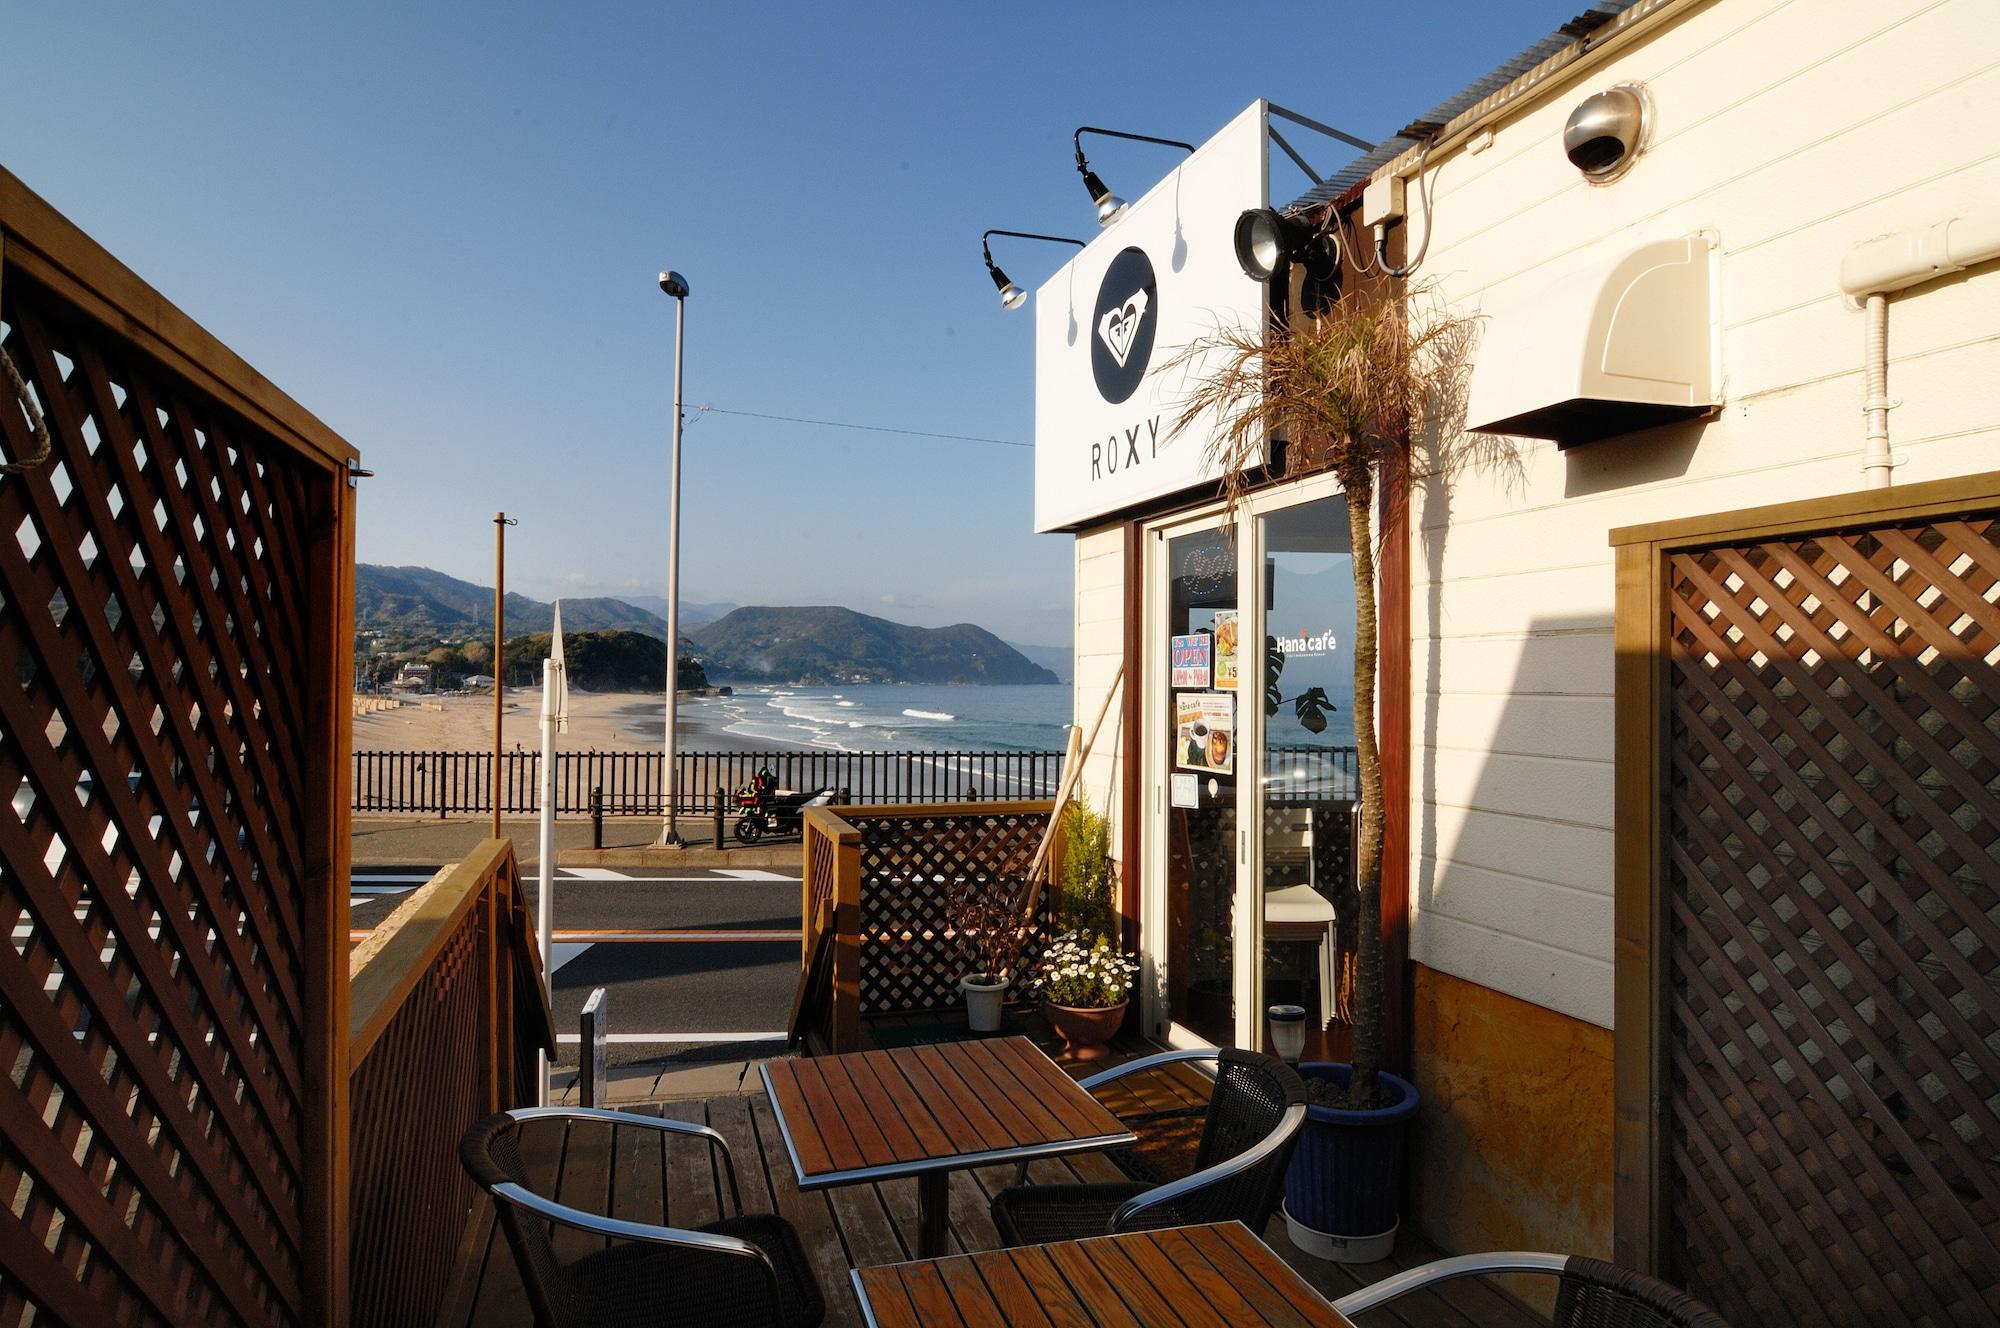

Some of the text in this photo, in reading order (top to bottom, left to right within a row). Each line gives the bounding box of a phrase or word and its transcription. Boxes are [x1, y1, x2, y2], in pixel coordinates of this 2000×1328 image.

[1092, 414, 1160, 481] ROXY
[1276, 628, 1337, 653] Hana café
[1173, 647, 1209, 667] OPEN
